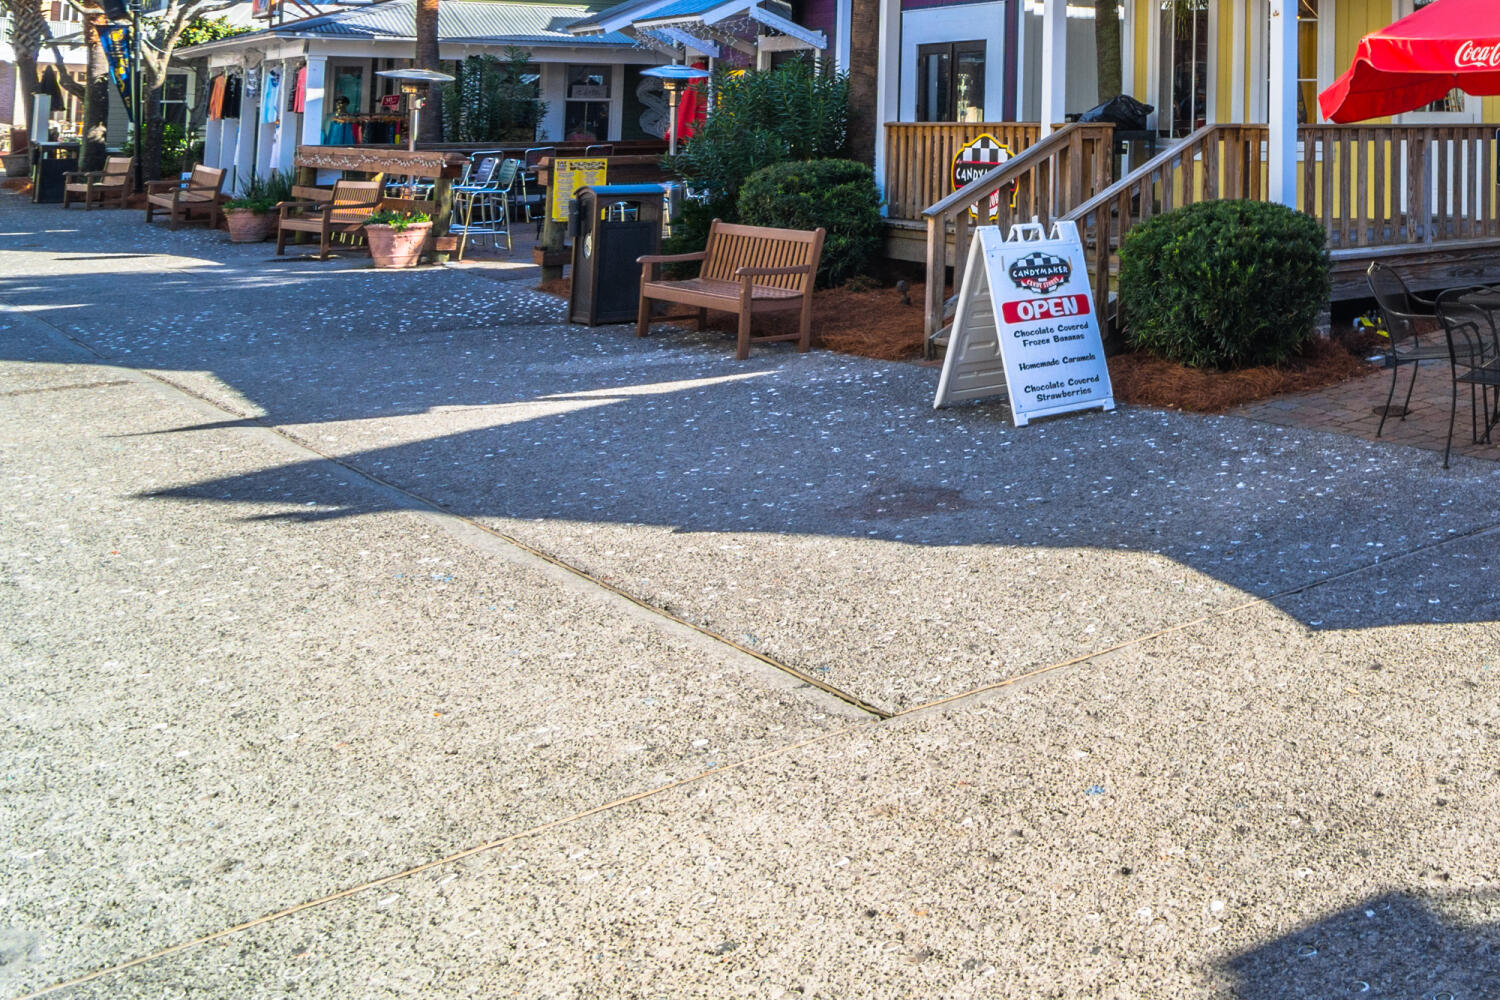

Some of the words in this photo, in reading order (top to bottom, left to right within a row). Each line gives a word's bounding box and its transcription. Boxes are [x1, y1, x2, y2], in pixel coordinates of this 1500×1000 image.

[1012, 266, 1068, 277] CANDYMAKER
[1017, 296, 1078, 320] OPEN
[1014, 326, 1054, 338] Chocolate
[1057, 321, 1088, 332] Covered
[1023, 337, 1050, 347] Frozen
[1053, 333, 1085, 343] Bananas
[1018, 358, 1060, 371] Homemade
[1062, 353, 1096, 364] Caramels
[1024, 381, 1065, 393] Chocolate
[1068, 374, 1100, 386] Covered
[1036, 386, 1092, 402] Strawberries
